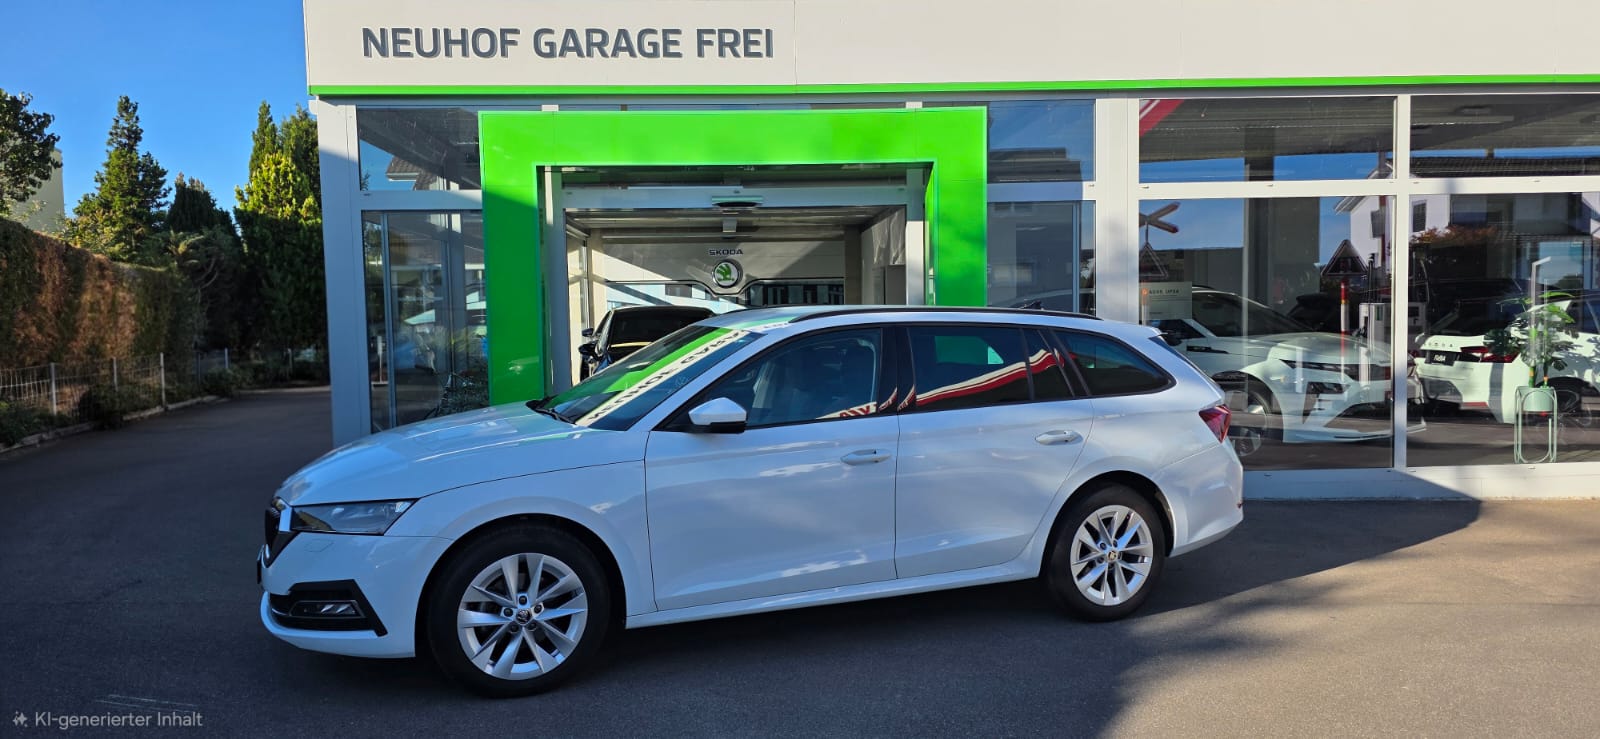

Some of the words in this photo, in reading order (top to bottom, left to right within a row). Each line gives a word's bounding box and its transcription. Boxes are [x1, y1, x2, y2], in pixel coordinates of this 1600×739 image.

[361, 27, 521, 58] NEUHOF
[533, 27, 683, 59] GARAGE
[696, 28, 774, 58] FREI
